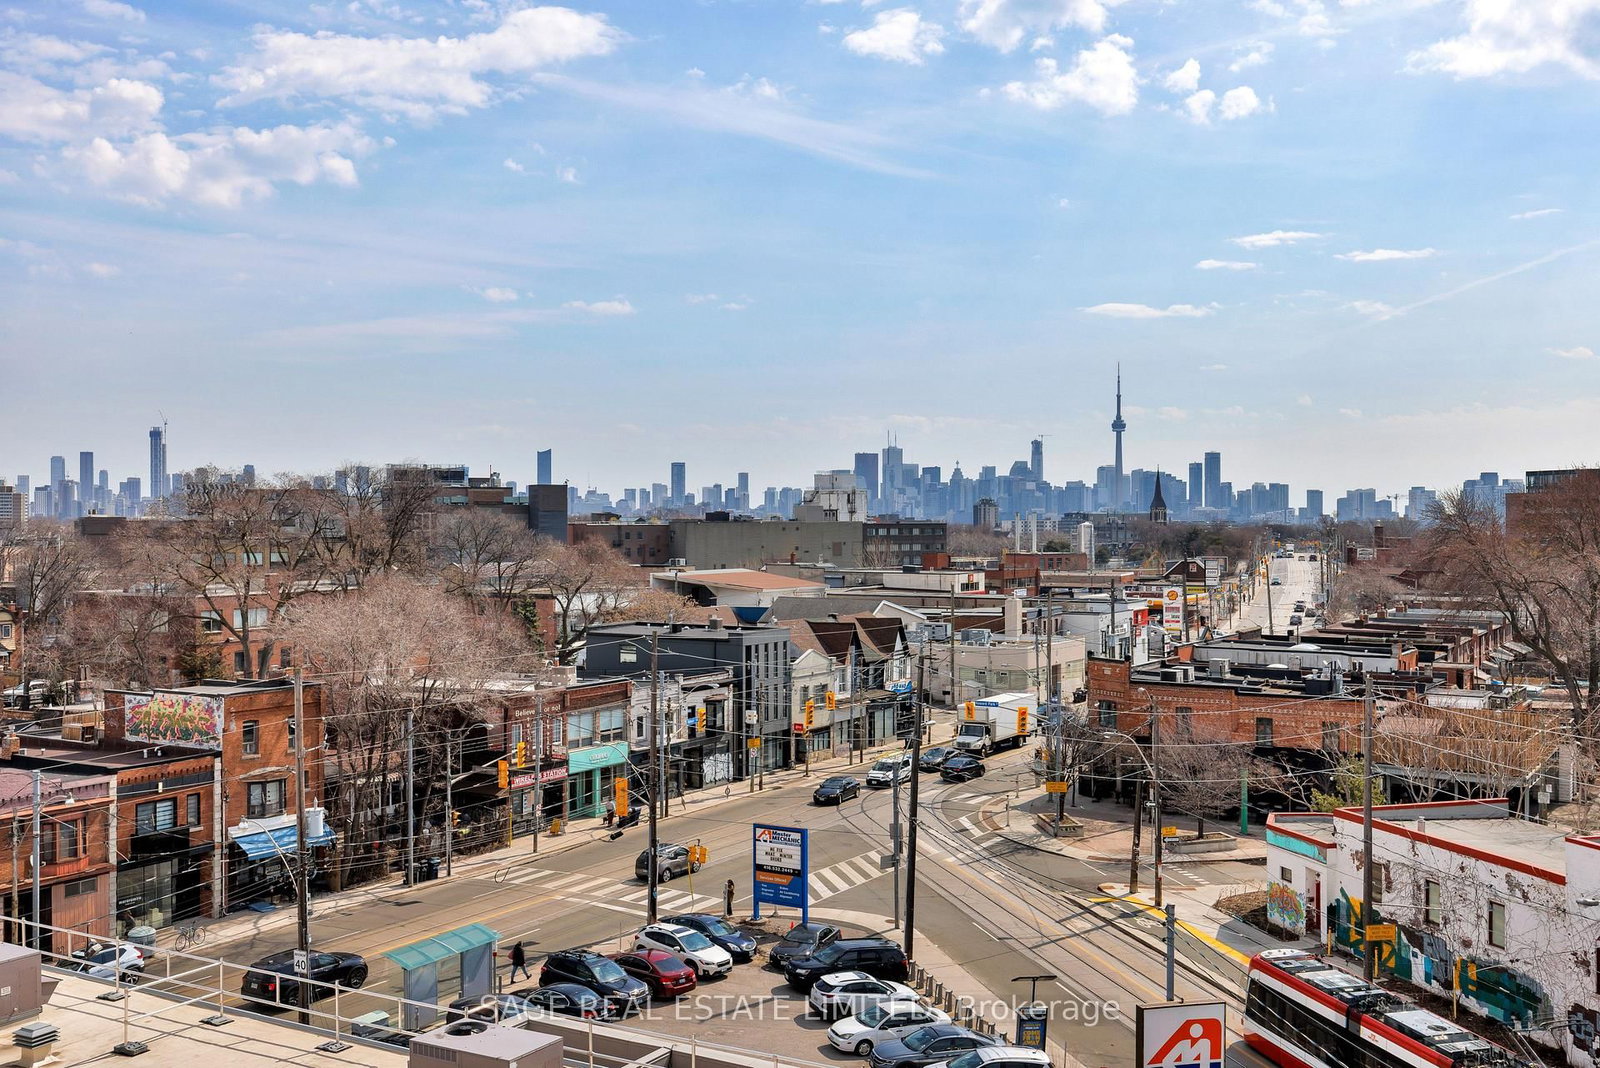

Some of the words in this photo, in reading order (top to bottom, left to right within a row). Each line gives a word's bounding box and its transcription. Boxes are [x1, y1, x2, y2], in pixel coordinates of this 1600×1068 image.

[515, 709, 536, 717] Believe
[543, 767, 567, 778] STATION
[772, 835, 801, 843] MECHANIC
[295, 959, 306, 970] 40
